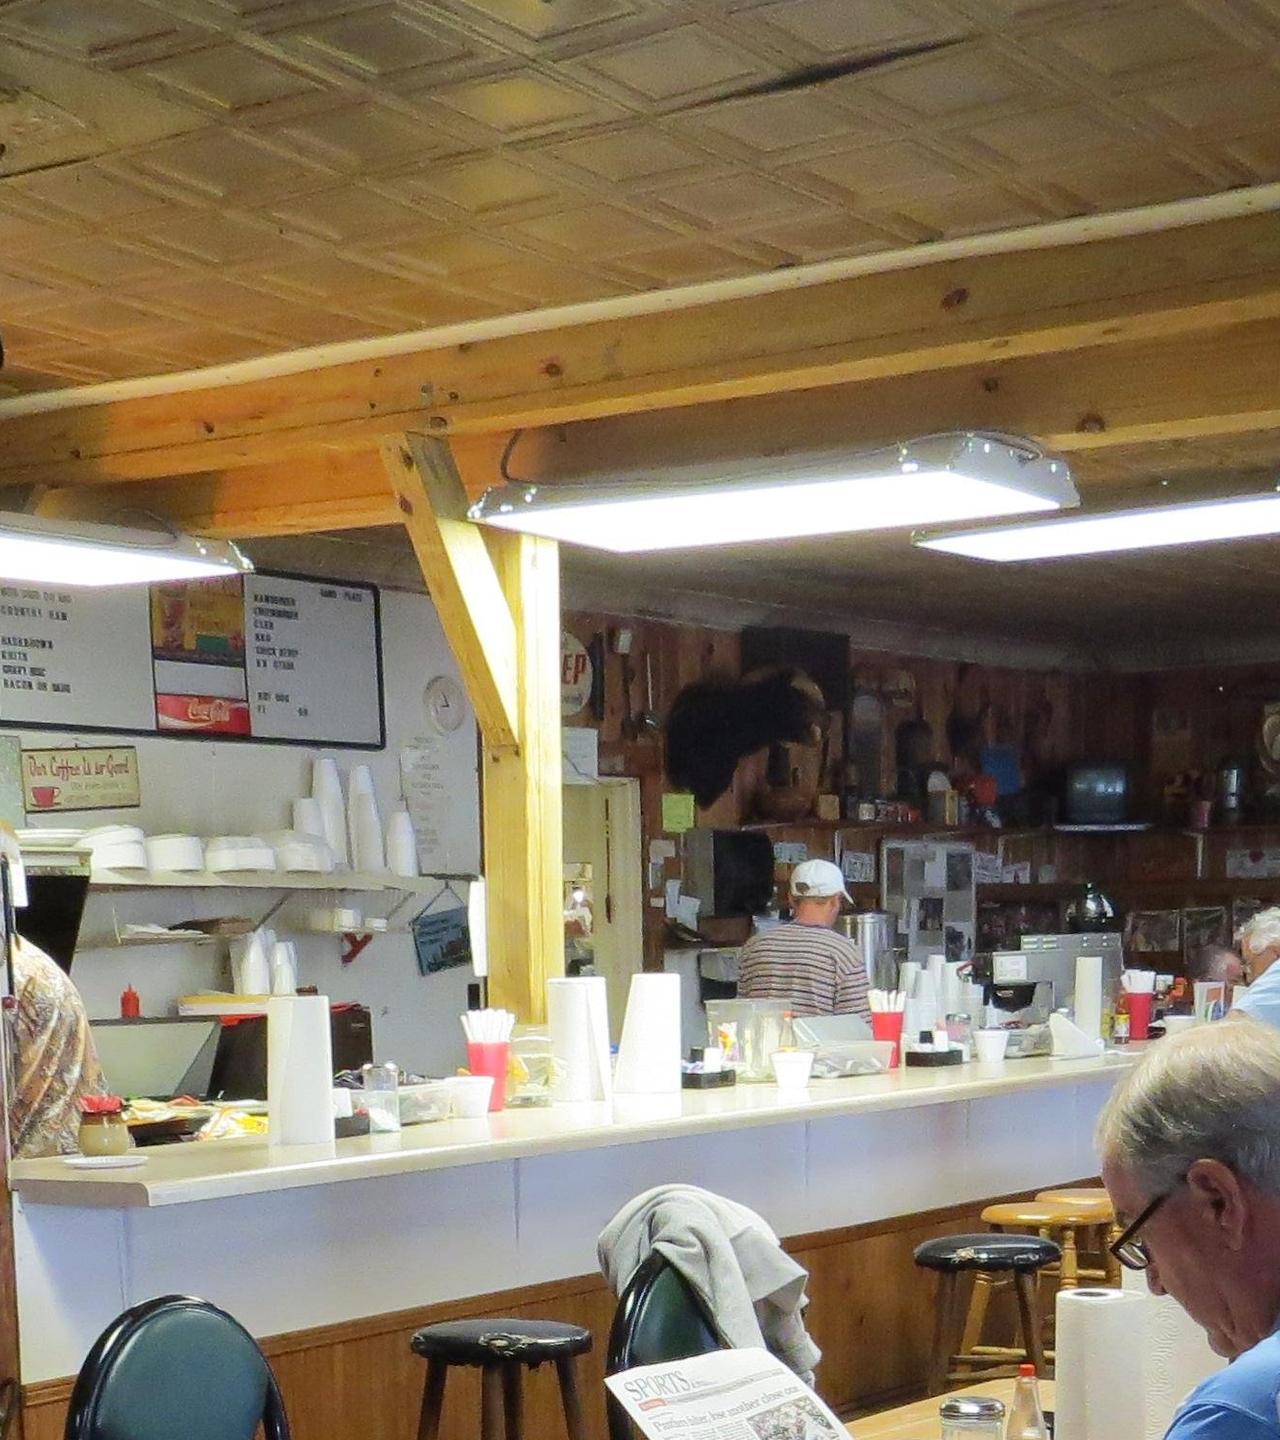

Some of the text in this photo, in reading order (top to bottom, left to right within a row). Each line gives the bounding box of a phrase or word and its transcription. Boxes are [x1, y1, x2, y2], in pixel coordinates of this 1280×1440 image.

[3, 678, 34, 691] BACON
[50, 755, 81, 781] Coffee
[624, 1370, 692, 1402] SPORTS
